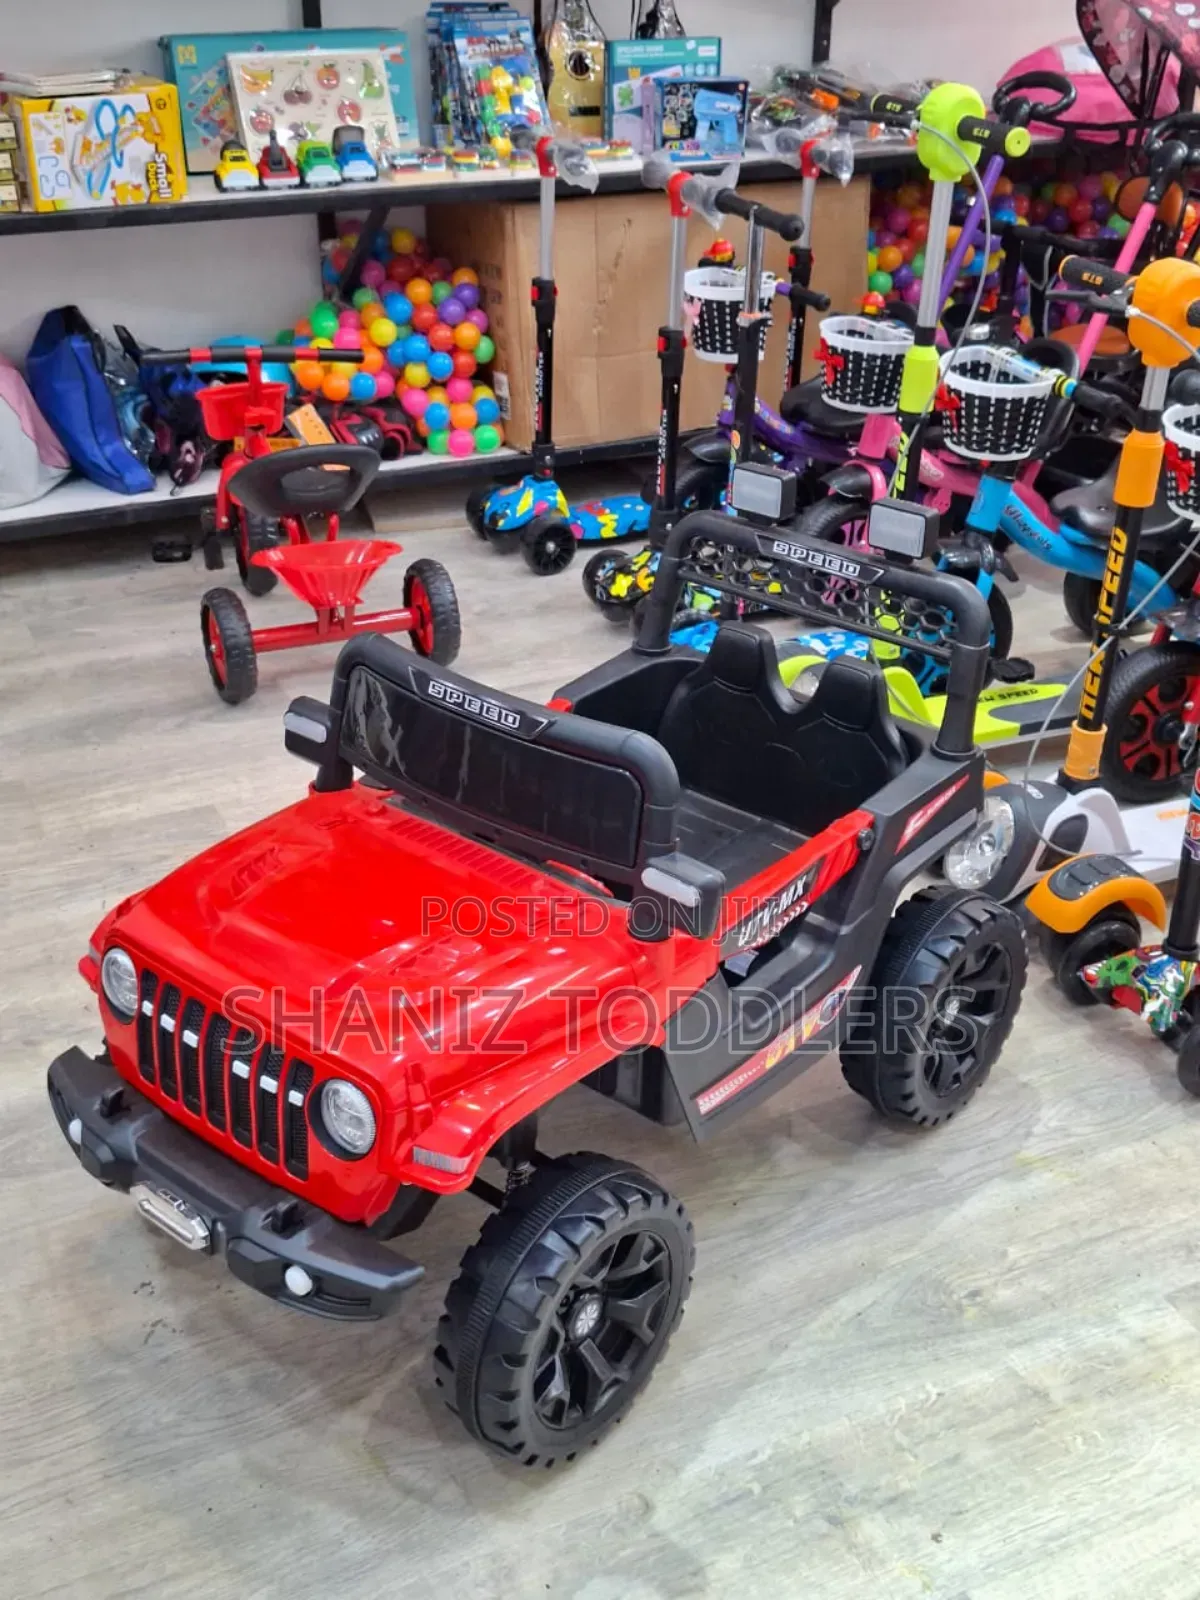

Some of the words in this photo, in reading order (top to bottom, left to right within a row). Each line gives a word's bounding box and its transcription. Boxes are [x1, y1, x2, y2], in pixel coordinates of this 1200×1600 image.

[154, 152, 172, 198] Small
[772, 540, 861, 577] SPEED
[428, 680, 521, 729] SPEED
